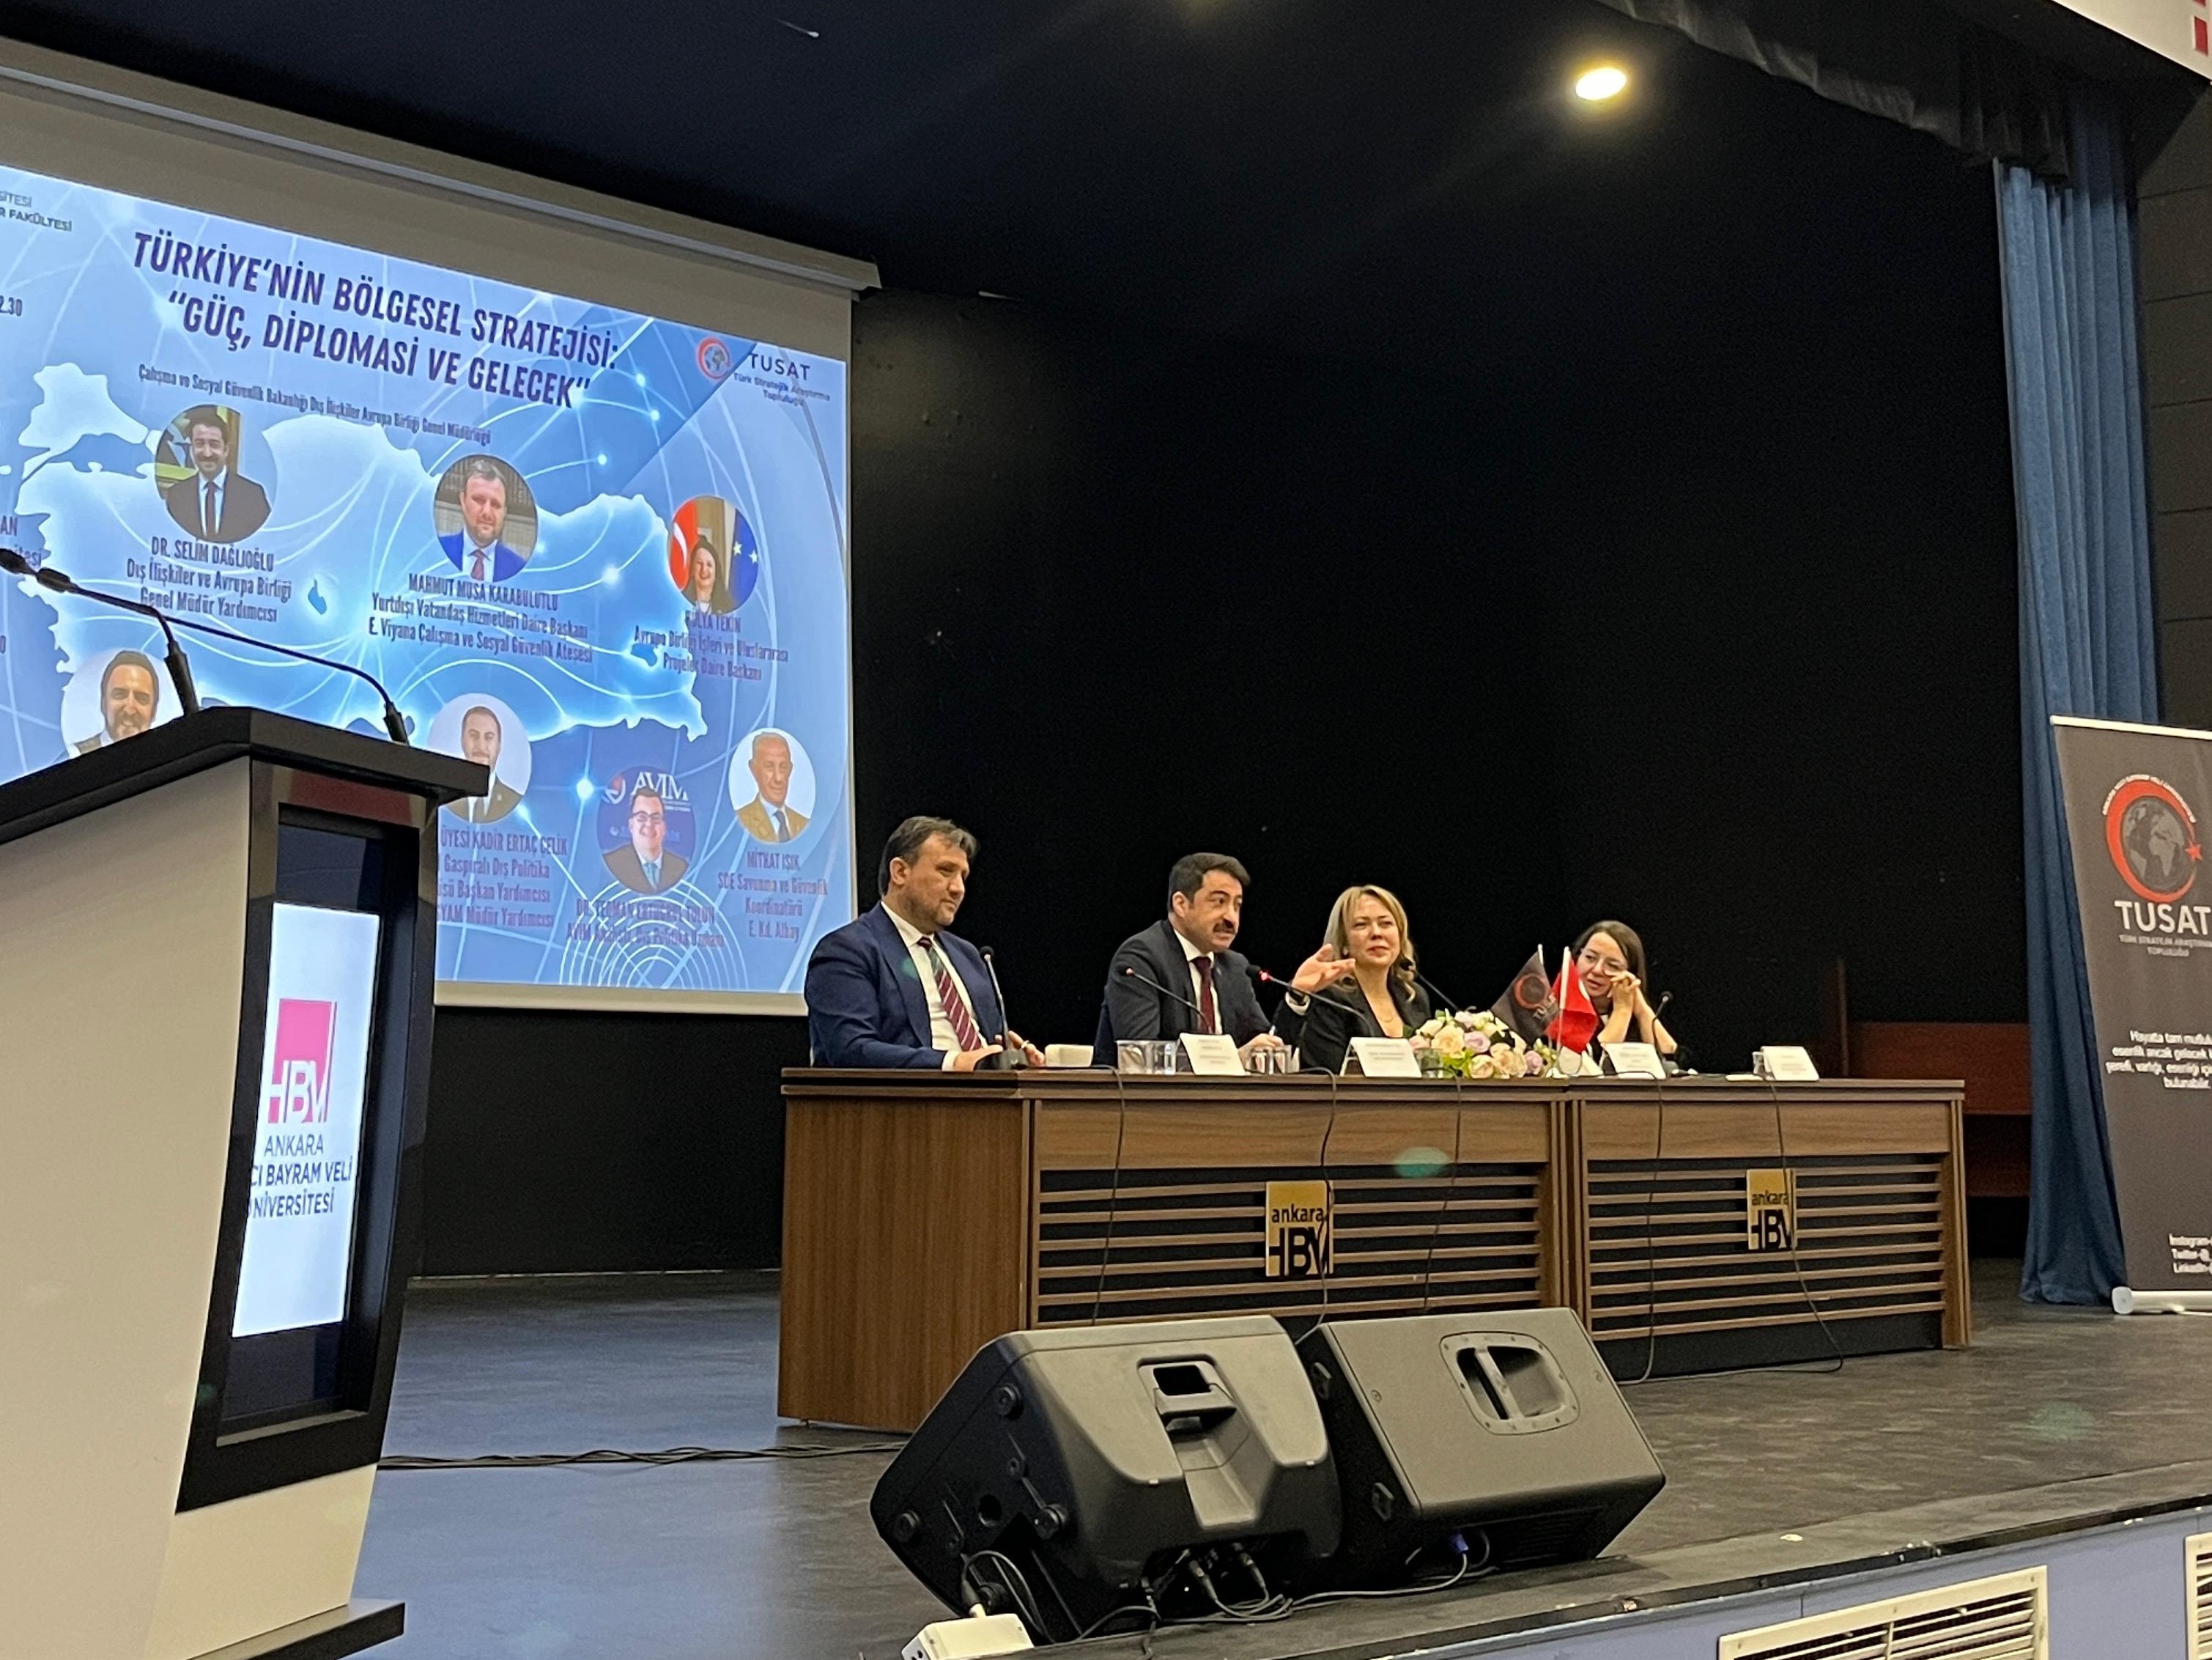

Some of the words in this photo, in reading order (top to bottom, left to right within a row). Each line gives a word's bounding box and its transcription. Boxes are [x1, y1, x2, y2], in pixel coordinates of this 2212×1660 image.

[134, 229, 325, 306] TÜRKİYE'NİN
[333, 275, 462, 336] BÖLGESEL
[471, 309, 618, 369] STRATEJİSİ:
[263, 310, 418, 377] DİPLOMASİ
[429, 347, 461, 386] VE
[748, 351, 811, 381] TUSAT
[152, 536, 170, 558] DR.
[174, 536, 209, 563] SELİM
[212, 545, 275, 572] DAĞLIOĞLU
[127, 558, 147, 583] Dış
[197, 572, 211, 589] ve
[213, 570, 254, 598] Avrupa
[408, 573, 455, 597] MAHMUT
[456, 580, 486, 602] MUSA
[141, 586, 174, 610] Genel
[177, 590, 215, 616] Müdür
[218, 597, 278, 623] Yardımcısı
[416, 598, 465, 625] Vatandaş
[380, 616, 416, 642] Viyana
[462, 633, 474, 648] ve
[476, 631, 510, 656] Sosyal
[473, 828, 504, 851] KADİR
[2114, 900, 2211, 935] TUSAT
[264, 1134, 324, 1157] ANKARA
[265, 1162, 322, 1187] BAYRAM
[325, 1155, 353, 1182] VELİ
[248, 1186, 335, 1219] NİVERSİTESİ
[1271, 1203, 1325, 1223] ankara
